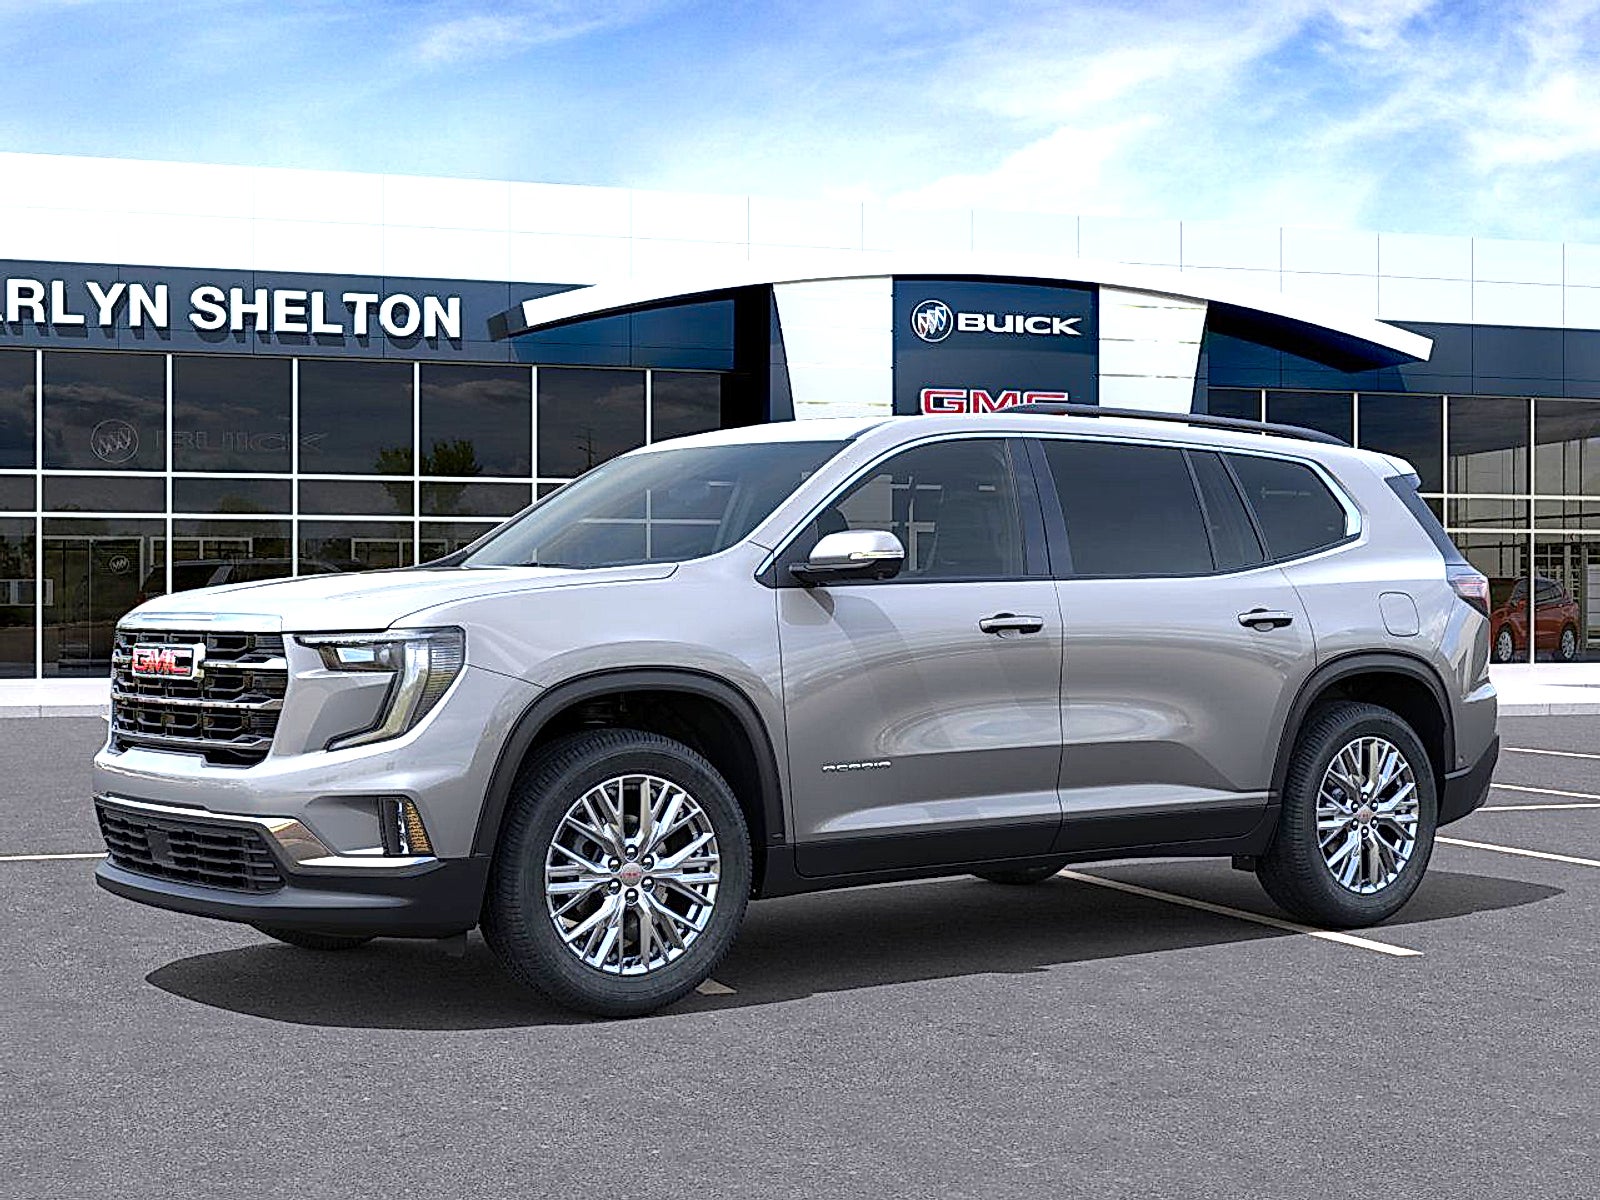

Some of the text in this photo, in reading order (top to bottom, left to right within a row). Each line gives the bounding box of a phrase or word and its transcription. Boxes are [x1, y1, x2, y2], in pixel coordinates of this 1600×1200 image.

[0, 278, 461, 337] RLYN SHELTON
[957, 312, 1082, 335] BUICK
[131, 646, 193, 674] GMC
